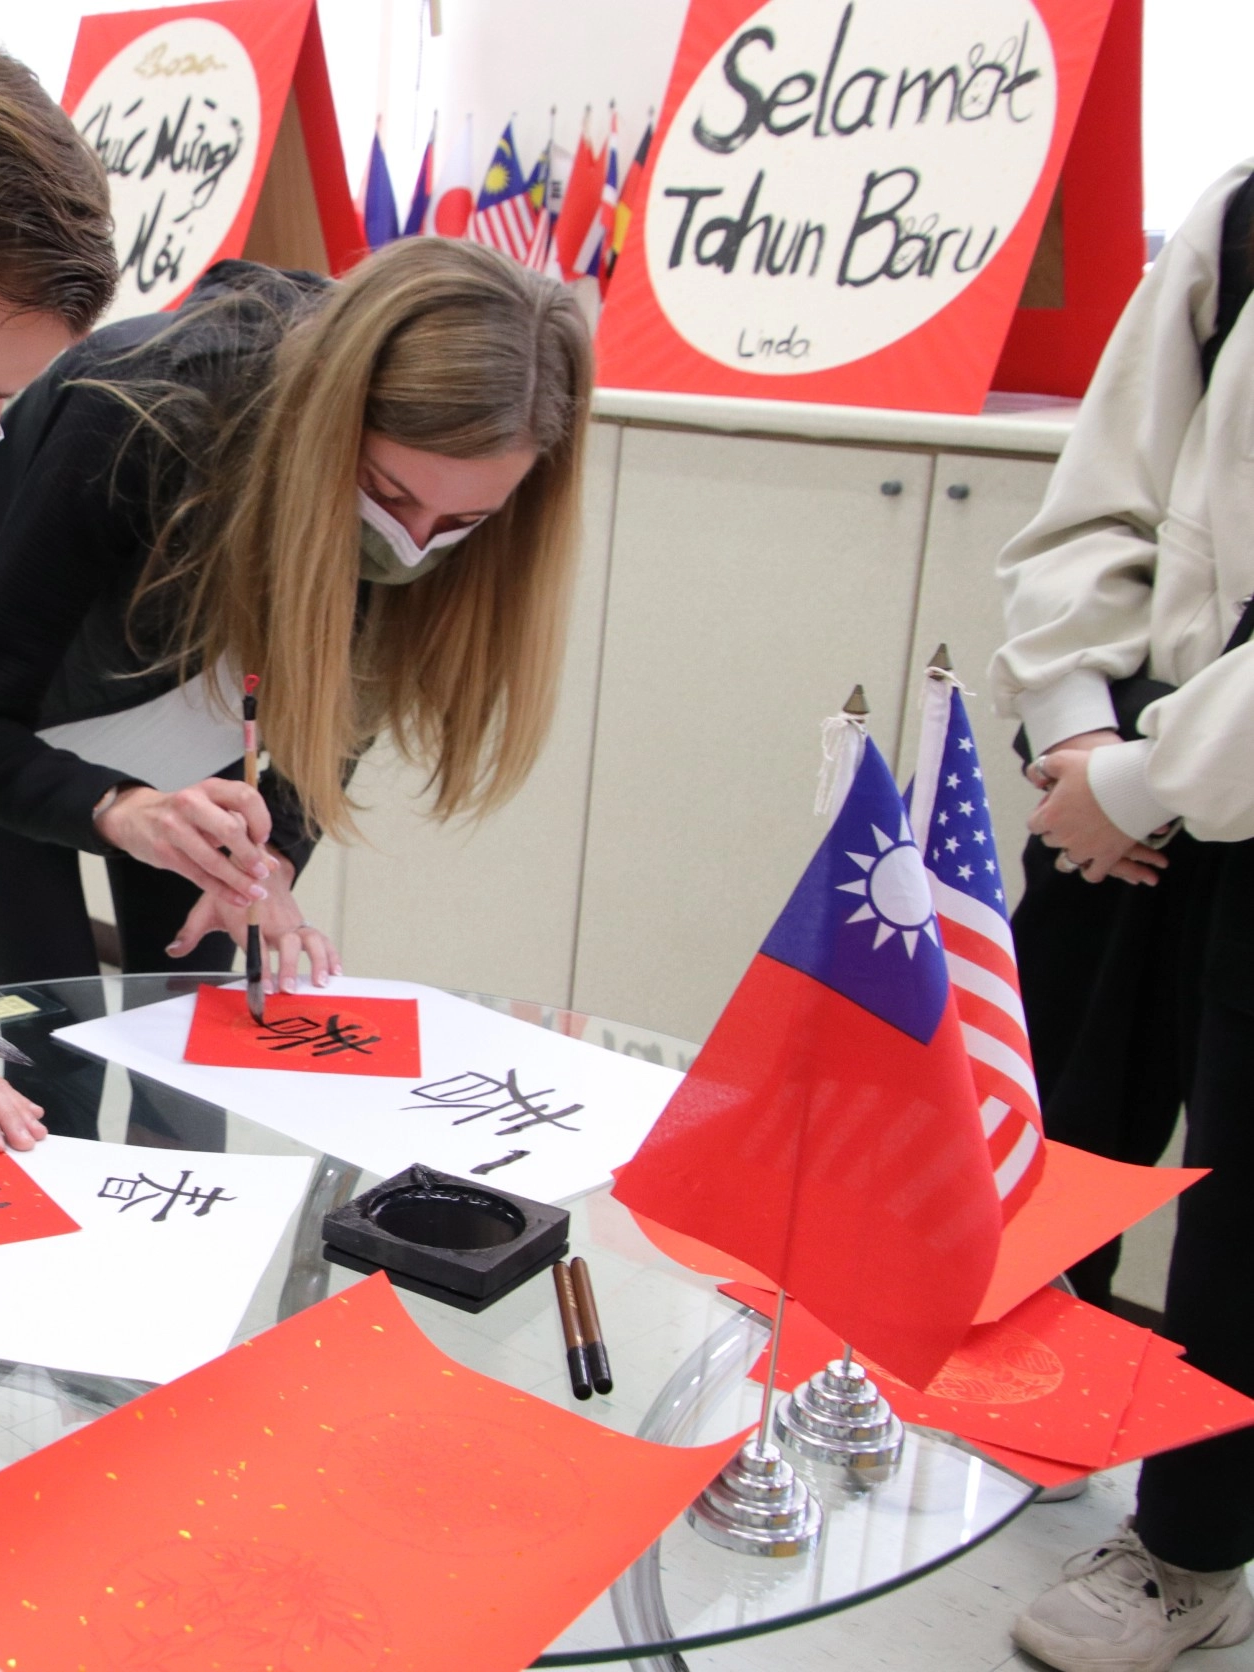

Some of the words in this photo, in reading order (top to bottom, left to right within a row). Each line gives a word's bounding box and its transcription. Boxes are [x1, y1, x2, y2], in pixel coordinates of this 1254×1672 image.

[692, 2, 1041, 154] Selamat
[663, 169, 826, 278] Tahun
[837, 167, 998, 288] Baru
[737, 324, 811, 358] Linda
[97, 1169, 237, 1222] 春
